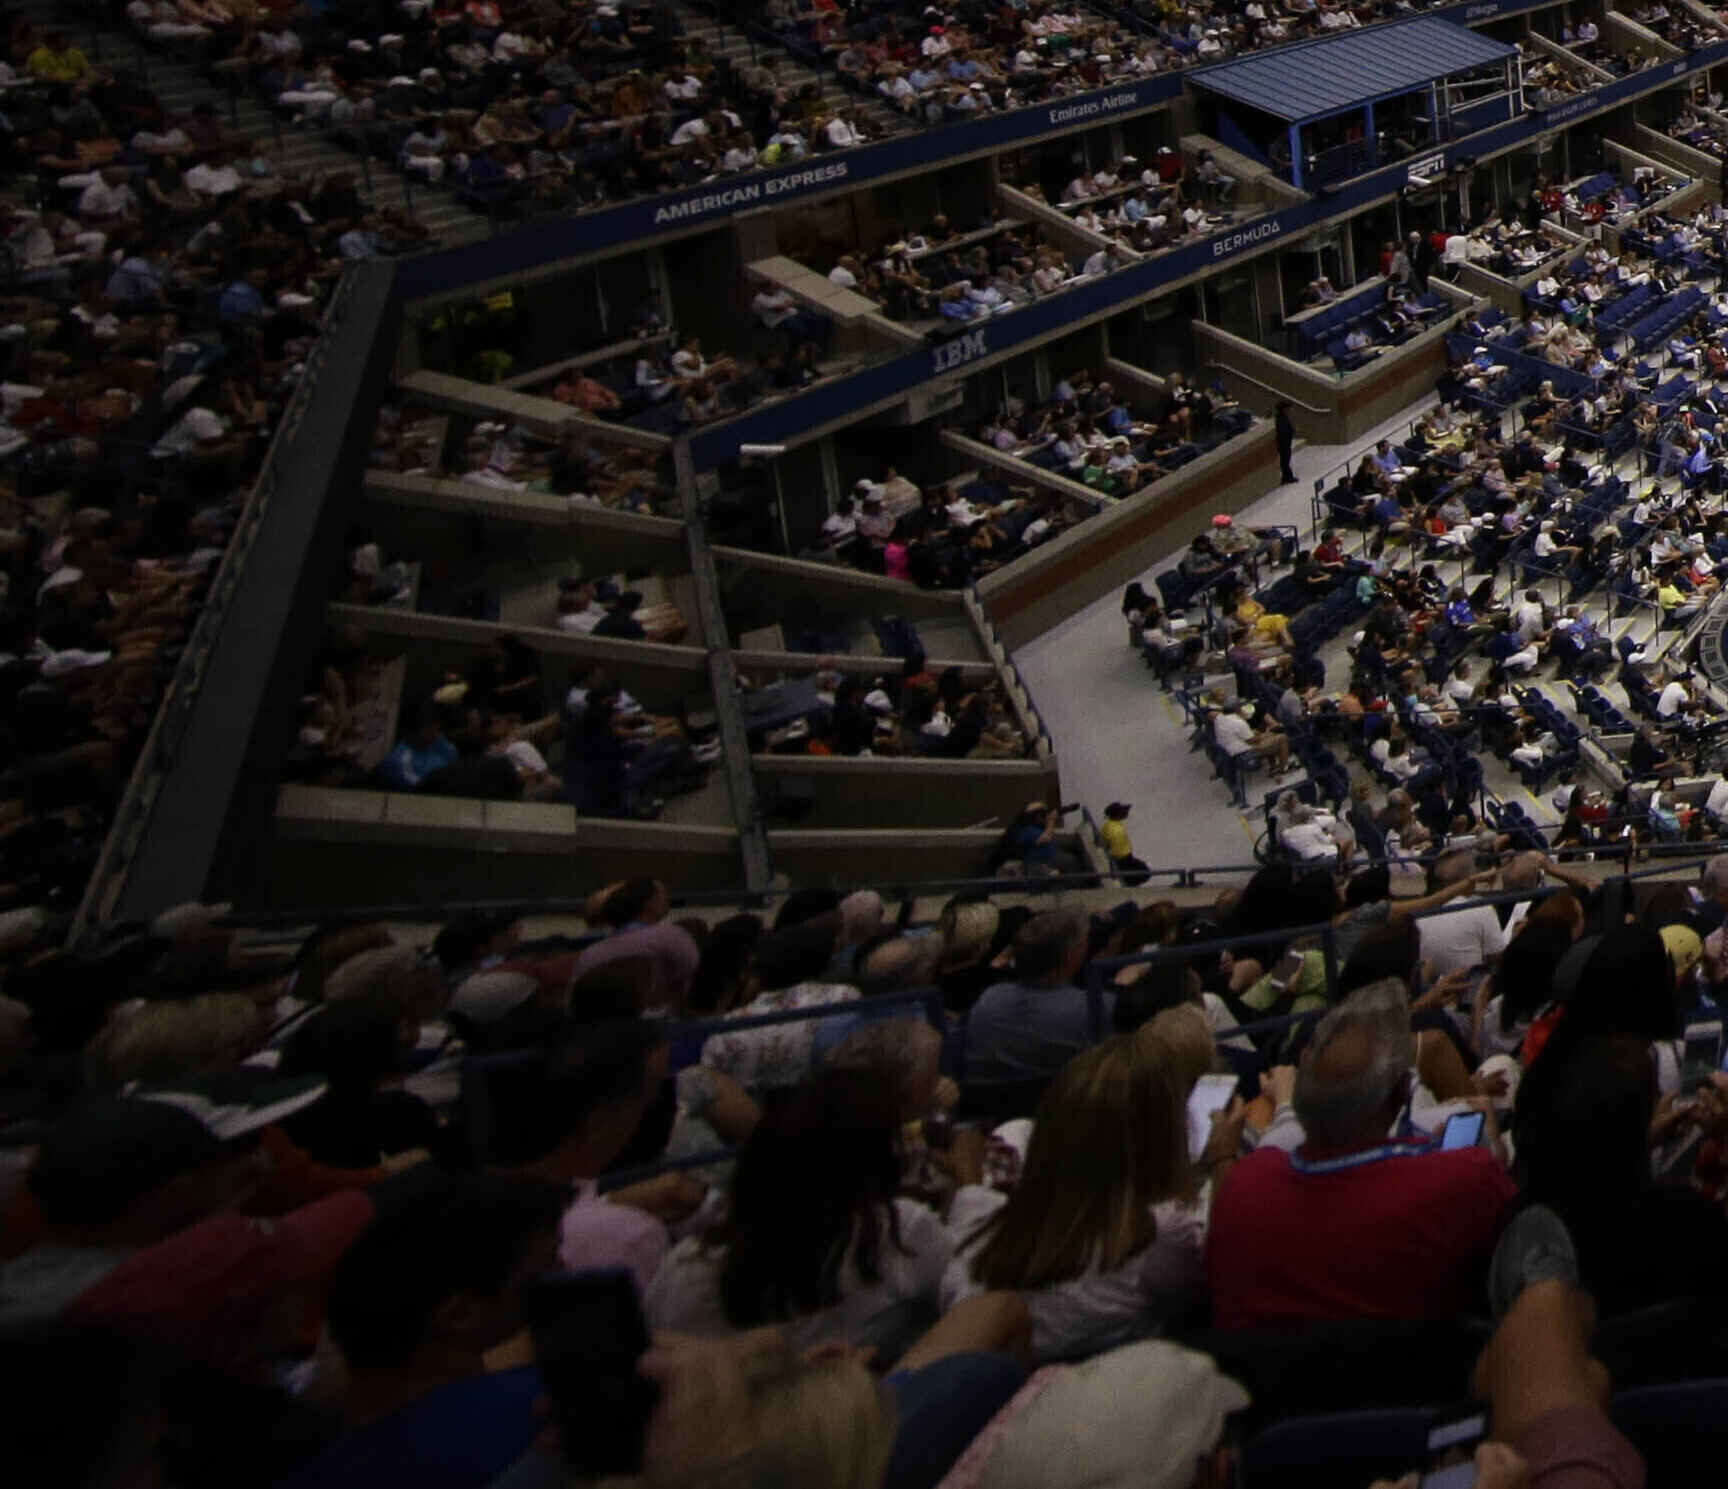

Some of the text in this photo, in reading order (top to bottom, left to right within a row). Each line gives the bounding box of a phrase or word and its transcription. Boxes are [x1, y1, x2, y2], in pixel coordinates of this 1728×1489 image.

[1049, 90, 1137, 124] Emirates Airline
[1407, 153, 1446, 180] ESPN
[654, 162, 848, 223] AMERICAN EXPRESS
[1213, 221, 1281, 257] BERMUDA
[932, 329, 987, 373] IBM
